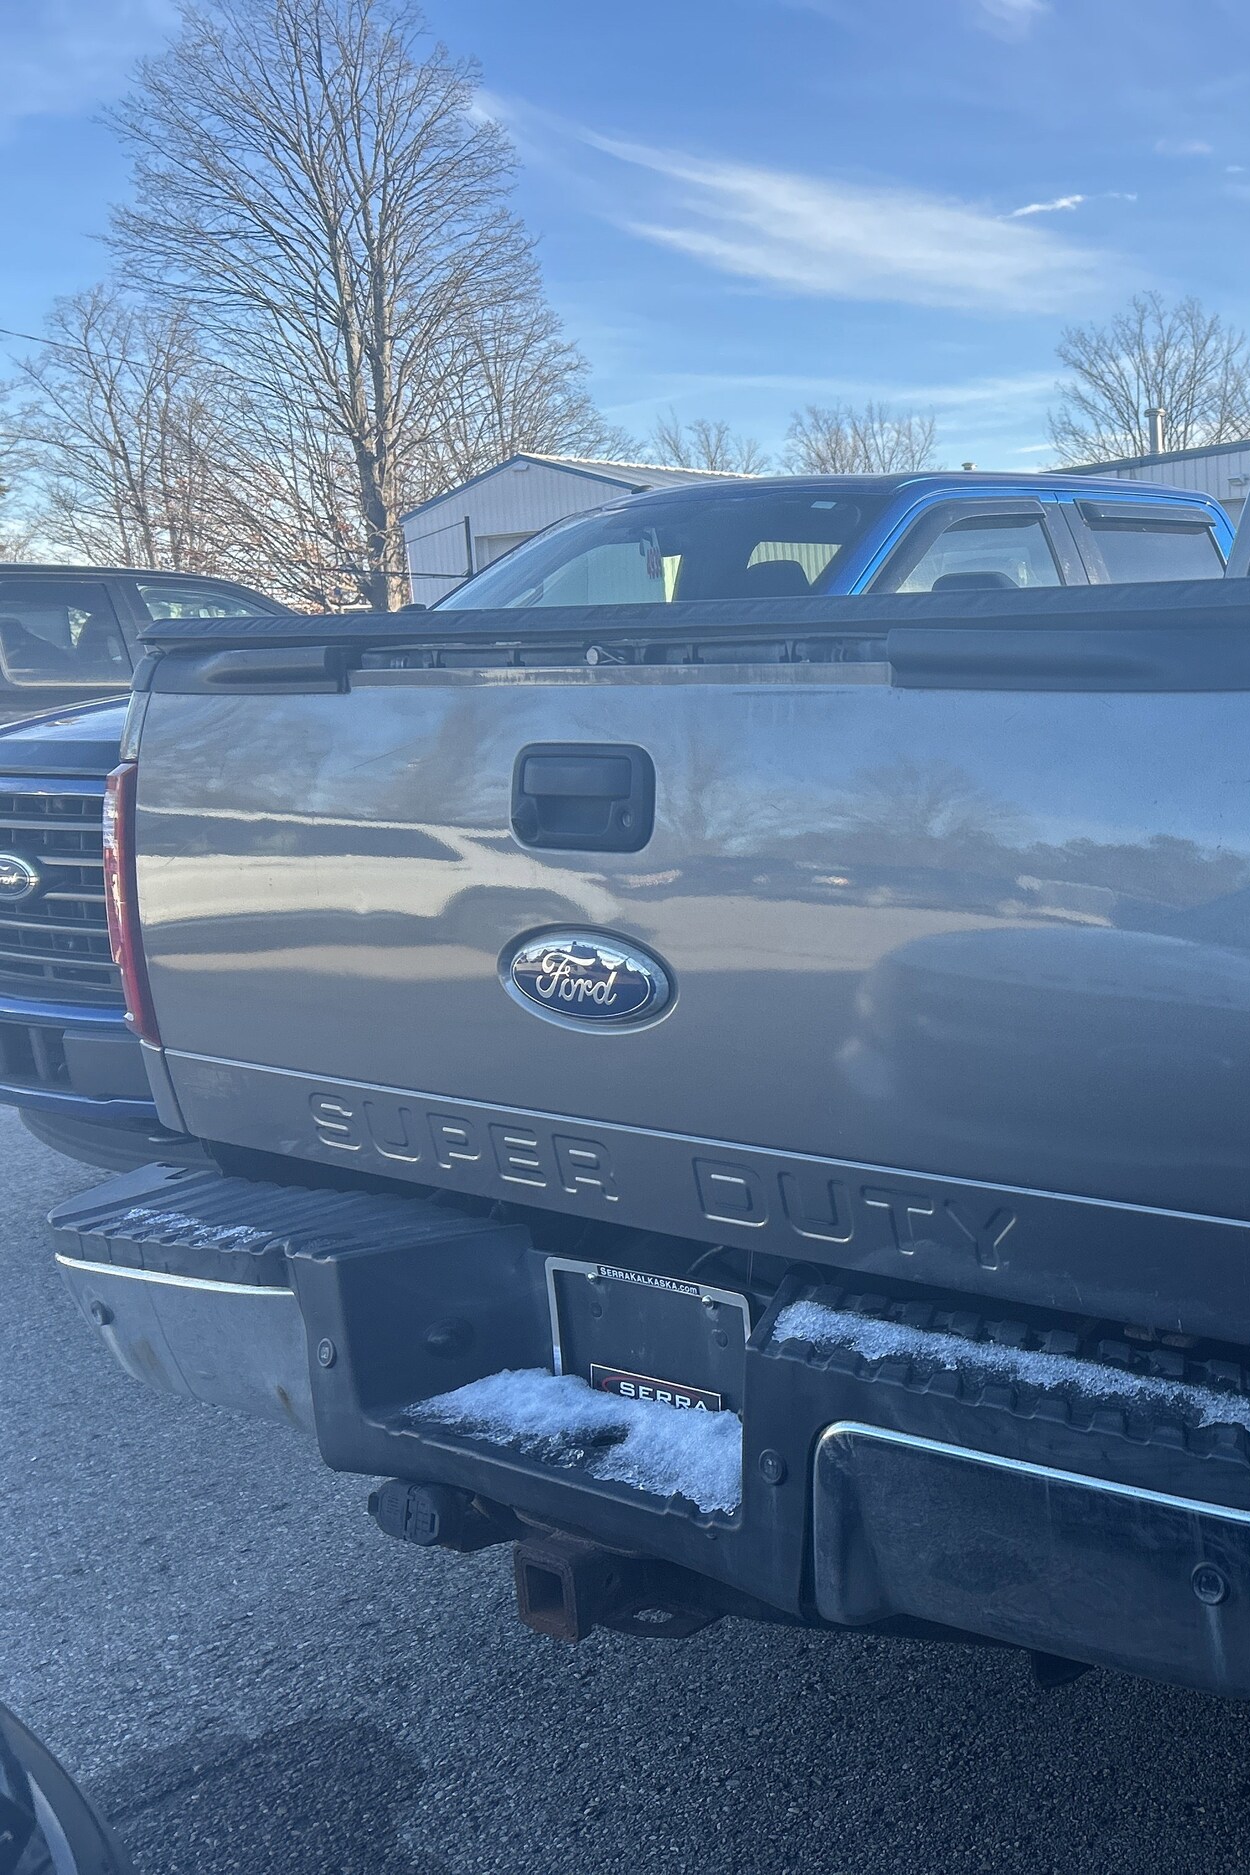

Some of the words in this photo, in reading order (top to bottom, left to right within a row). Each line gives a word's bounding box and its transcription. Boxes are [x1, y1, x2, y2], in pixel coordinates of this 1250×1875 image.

[535, 952, 619, 1006] Ford
[308, 1091, 619, 1202] SUPER
[691, 1160, 1017, 1271] DUTY
[618, 1381, 709, 1412] SERRA
